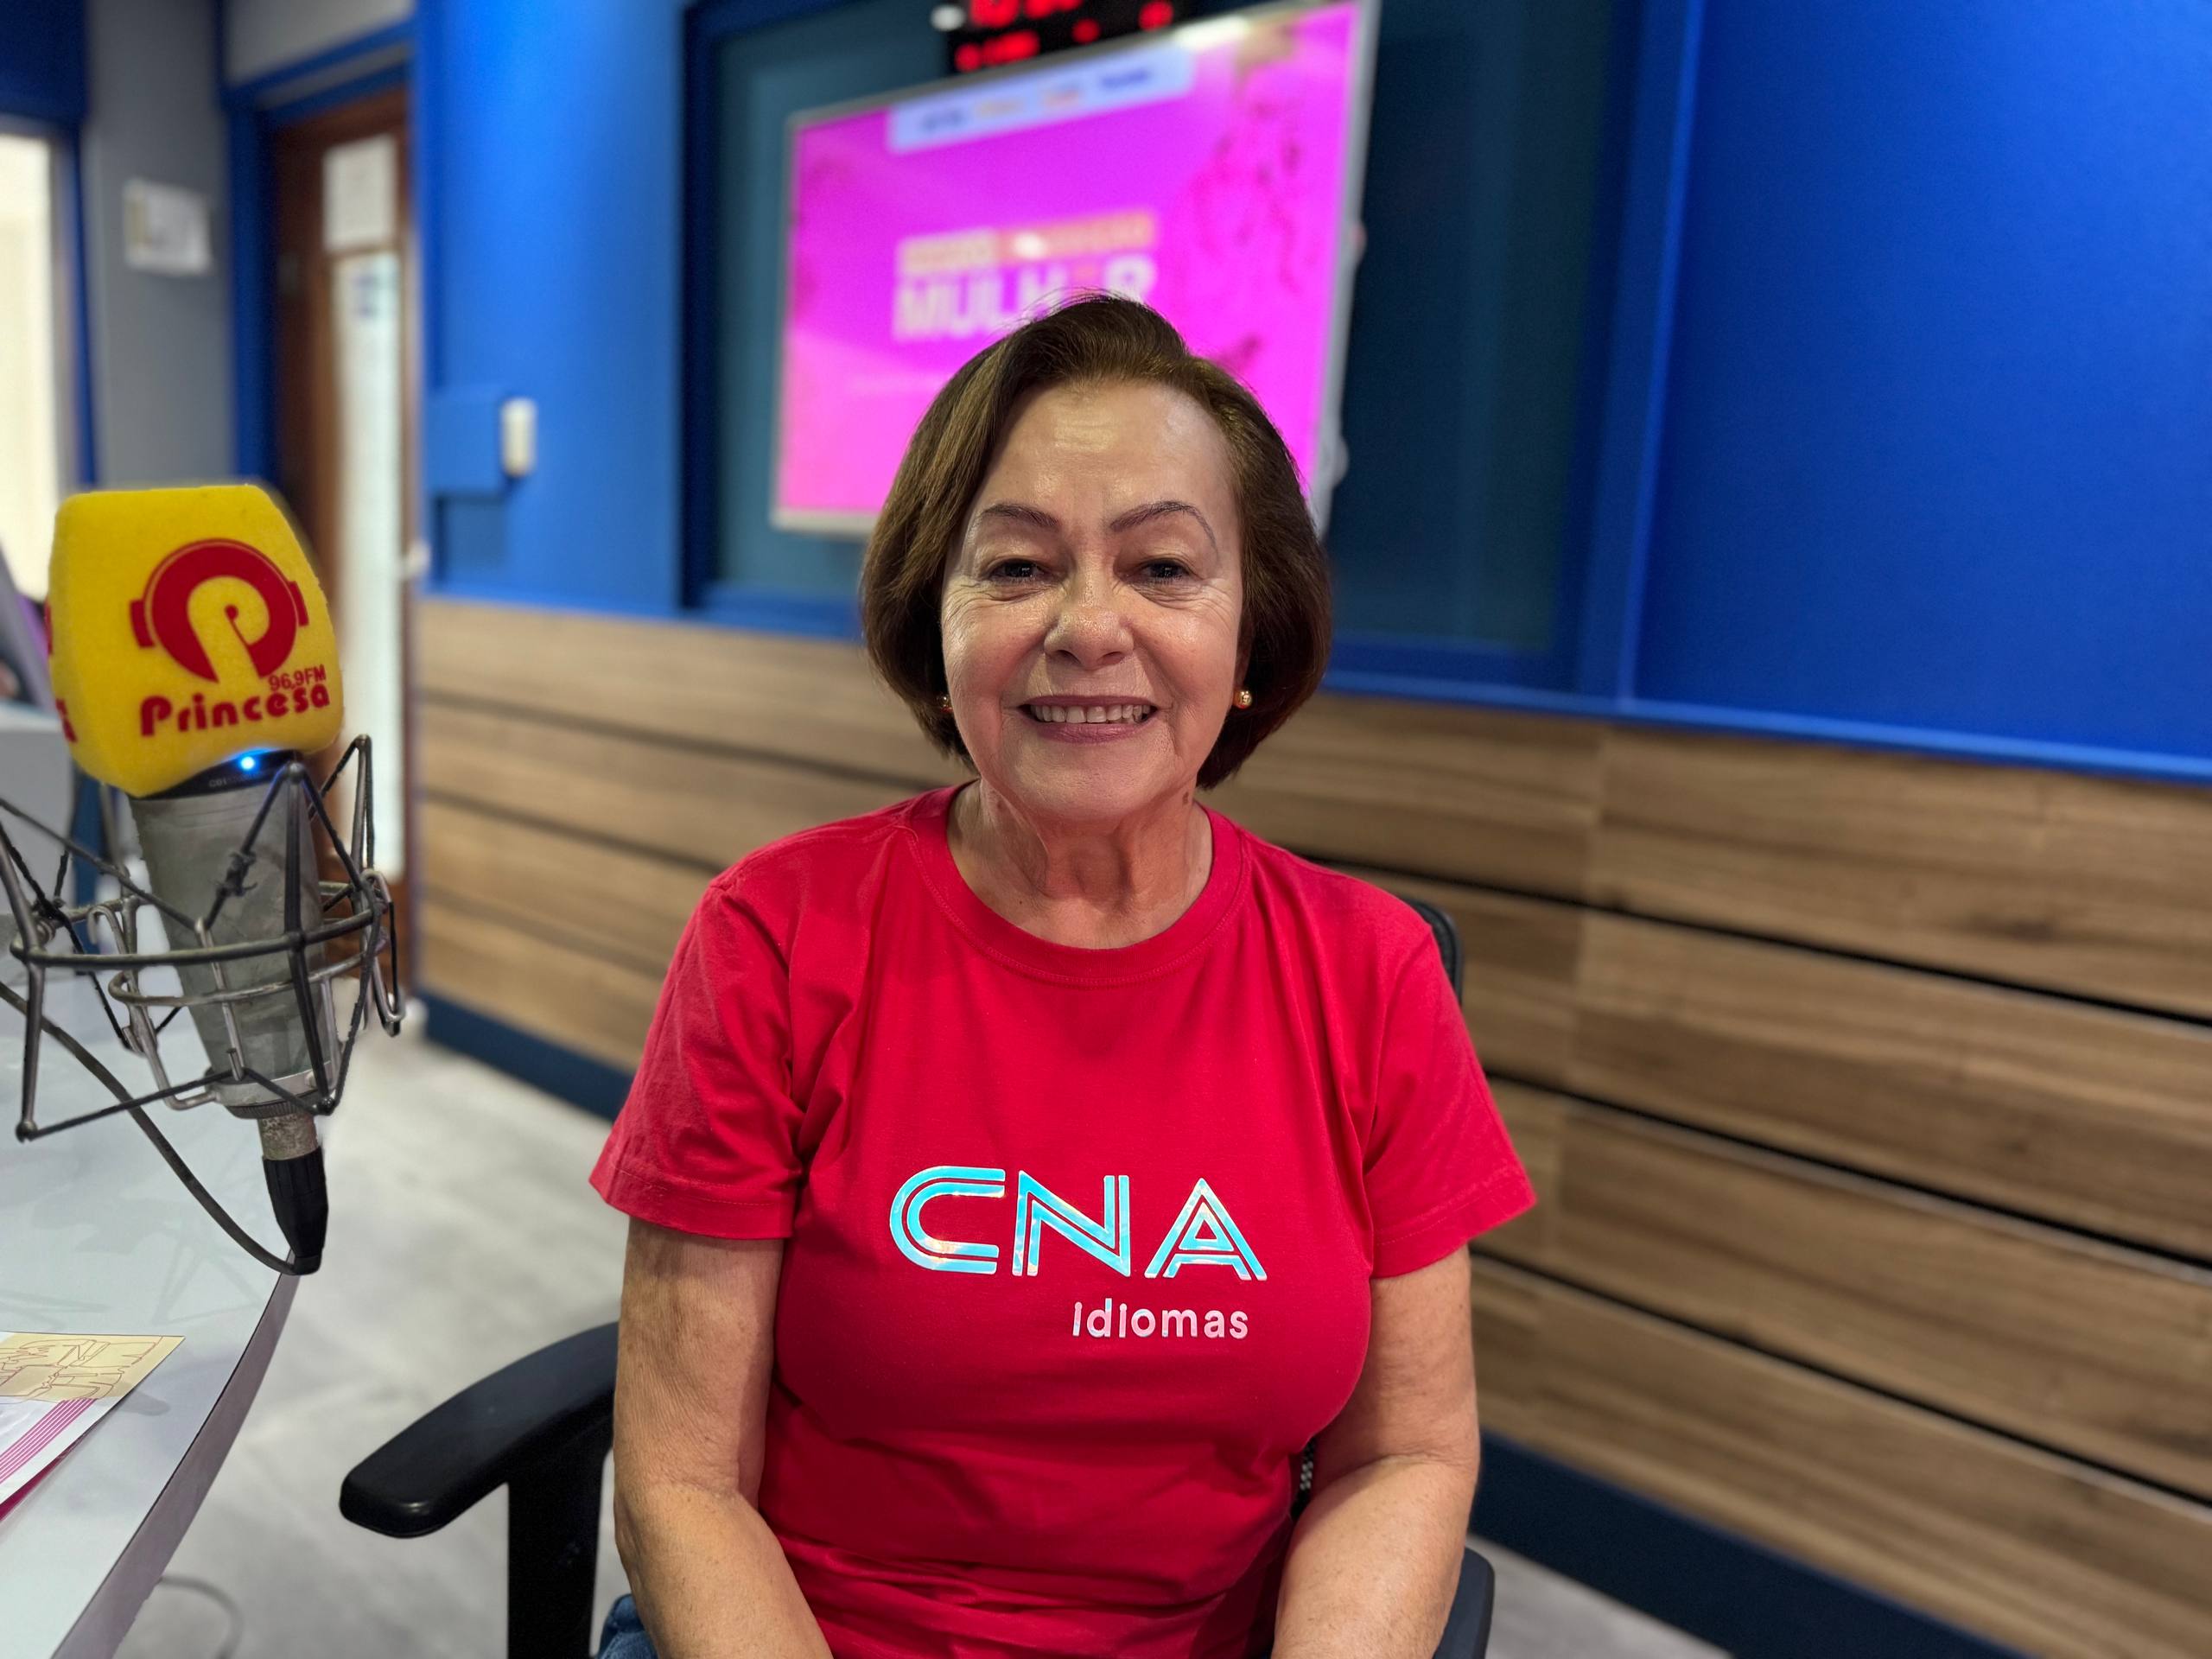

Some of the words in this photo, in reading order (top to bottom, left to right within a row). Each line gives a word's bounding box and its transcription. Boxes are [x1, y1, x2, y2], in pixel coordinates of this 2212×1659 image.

[141, 683, 330, 736] Princesa
[889, 1166, 1267, 1281] CNA
[1071, 1298, 1248, 1338] idiomas
